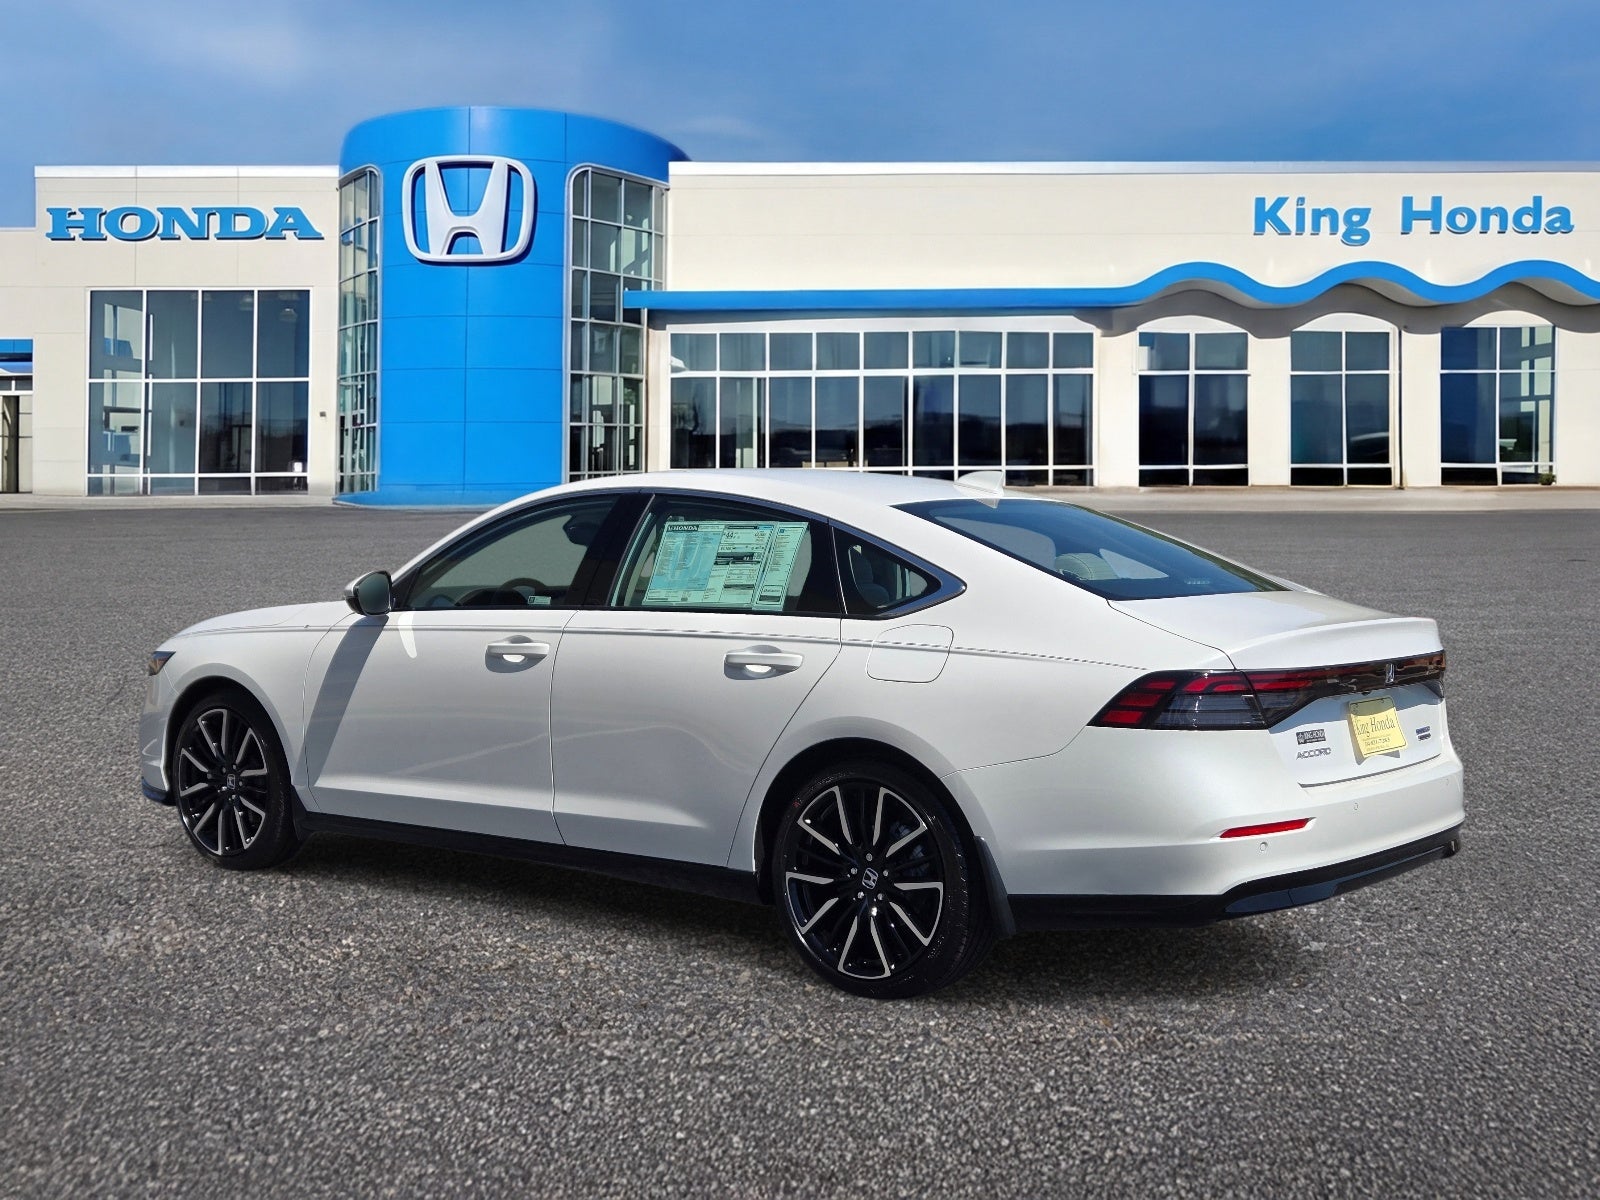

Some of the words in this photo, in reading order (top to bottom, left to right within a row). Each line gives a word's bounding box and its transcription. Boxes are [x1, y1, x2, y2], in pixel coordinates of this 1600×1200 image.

[45, 206, 325, 241] HONDA
[1253, 196, 1372, 246] King
[1400, 195, 1575, 234] Honda
[1355, 722, 1371, 738] King
[1370, 715, 1396, 733] Honda
[1296, 747, 1332, 760] ACCORD
